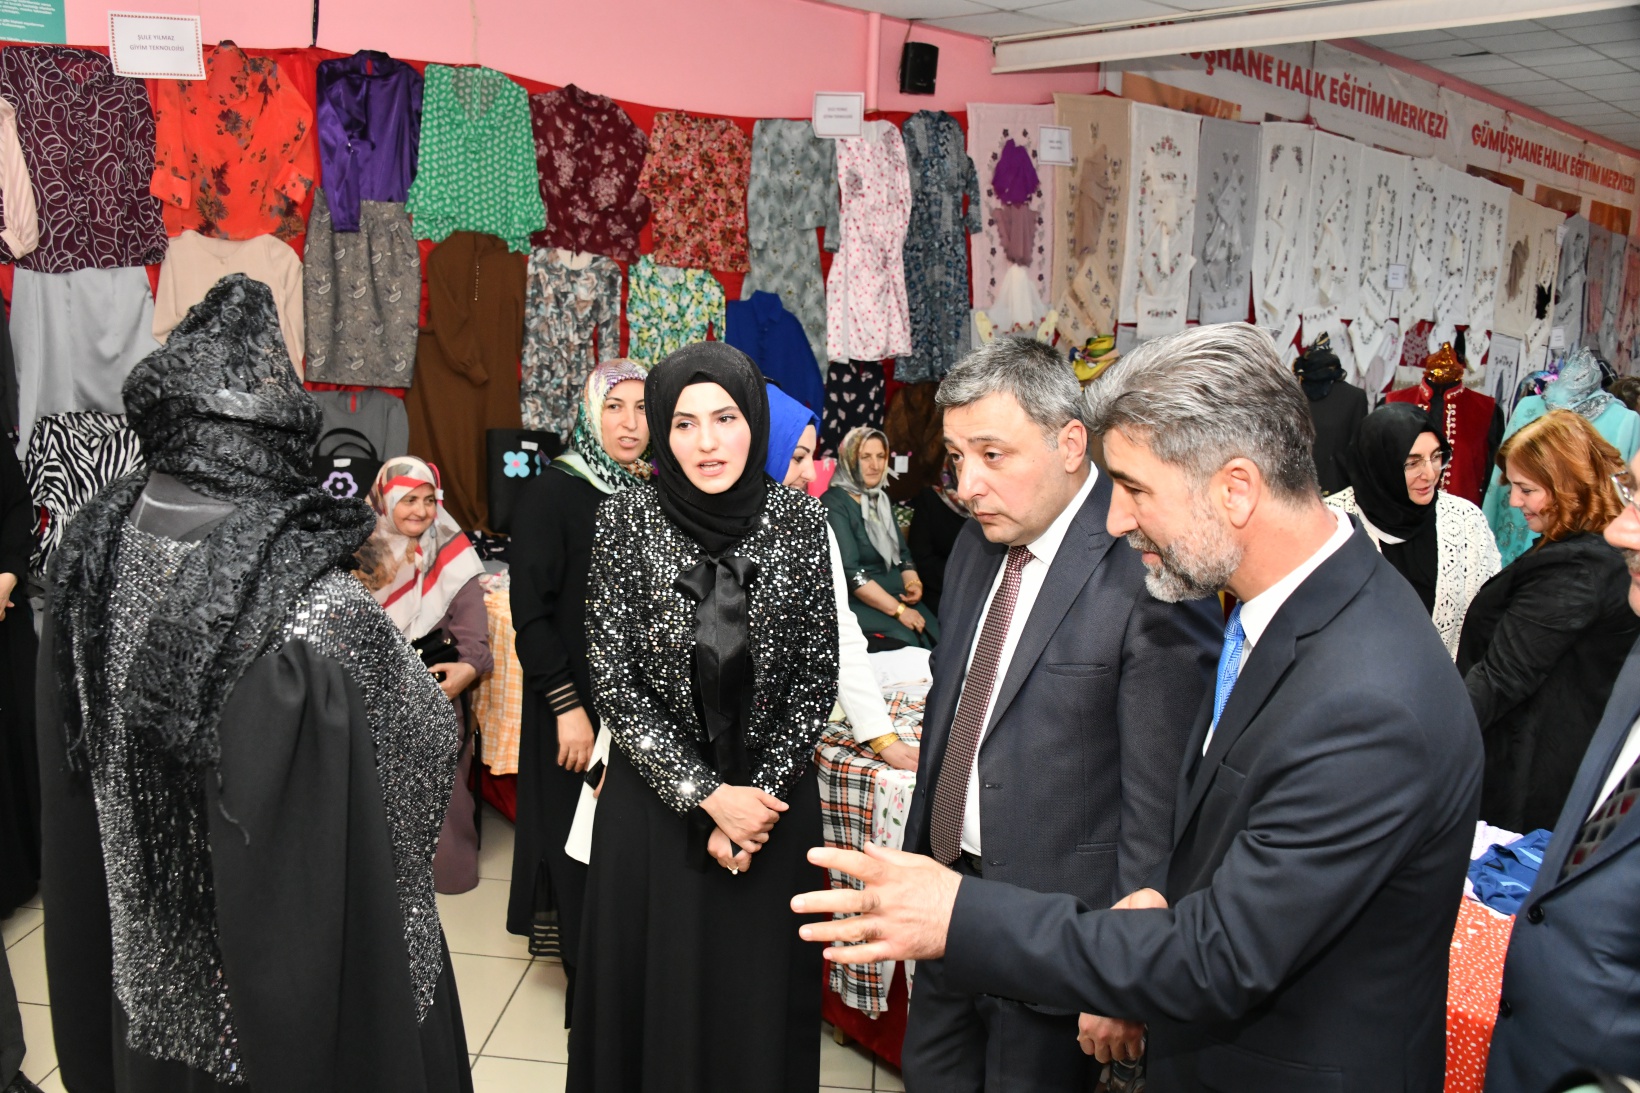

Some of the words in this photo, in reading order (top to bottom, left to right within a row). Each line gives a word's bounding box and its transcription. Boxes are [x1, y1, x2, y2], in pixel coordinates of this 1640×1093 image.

[1276, 59, 1327, 101] HALK
[1329, 72, 1386, 120] EĞİTİM
[1386, 96, 1449, 140] MERKEZİ
[1471, 120, 1543, 166] GÜMÜŞHANE
[1543, 147, 1569, 175] HALK
[1569, 153, 1601, 185] EĞİTİM
[1600, 165, 1636, 195] MERKEZİ
